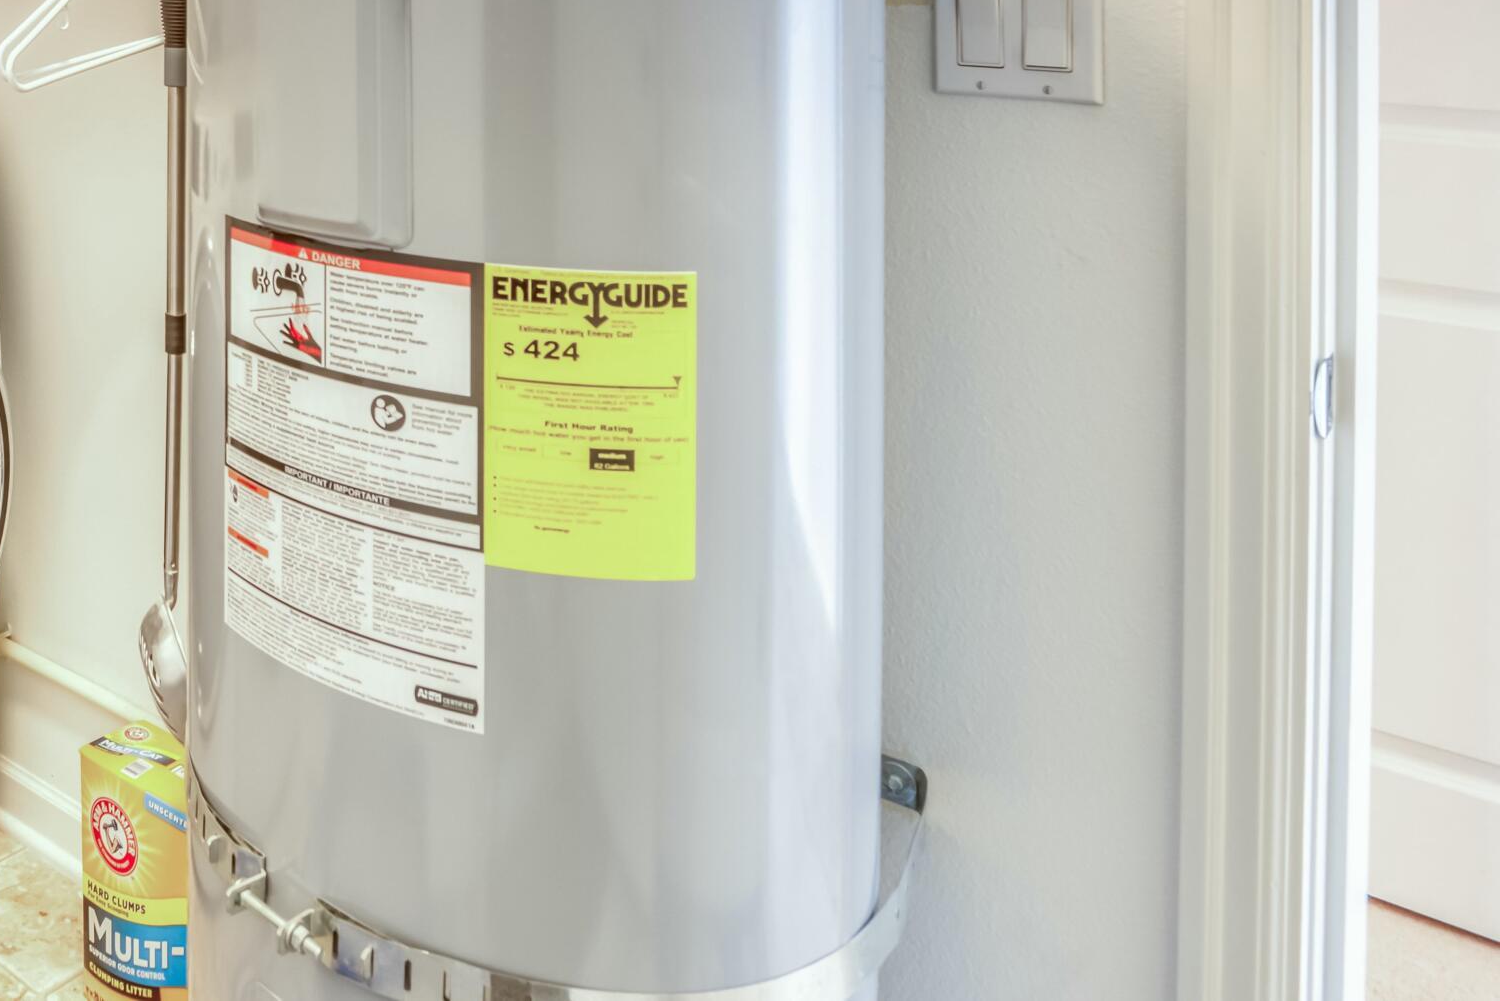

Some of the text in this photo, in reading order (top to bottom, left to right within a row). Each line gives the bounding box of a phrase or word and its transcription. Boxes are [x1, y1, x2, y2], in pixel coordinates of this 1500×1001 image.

[311, 251, 361, 270] DANGER
[493, 275, 688, 309] ENERGYGUIDE
[587, 328, 613, 339] Energy
[523, 339, 580, 361] 424
[544, 420, 634, 434] First Hour Rating
[285, 465, 328, 489] IMPORTANT
[333, 481, 391, 507] IMPORTANTE
[108, 802, 137, 857] HAMMER
[148, 800, 188, 830] UNSCENTE
[87, 880, 146, 914] HARD CLUMPS
[88, 905, 185, 970] MULTI-
[88, 961, 154, 999] CLUMPING LITTER
[117, 963, 135, 977] ODOR
[136, 969, 166, 982] CONTROL
